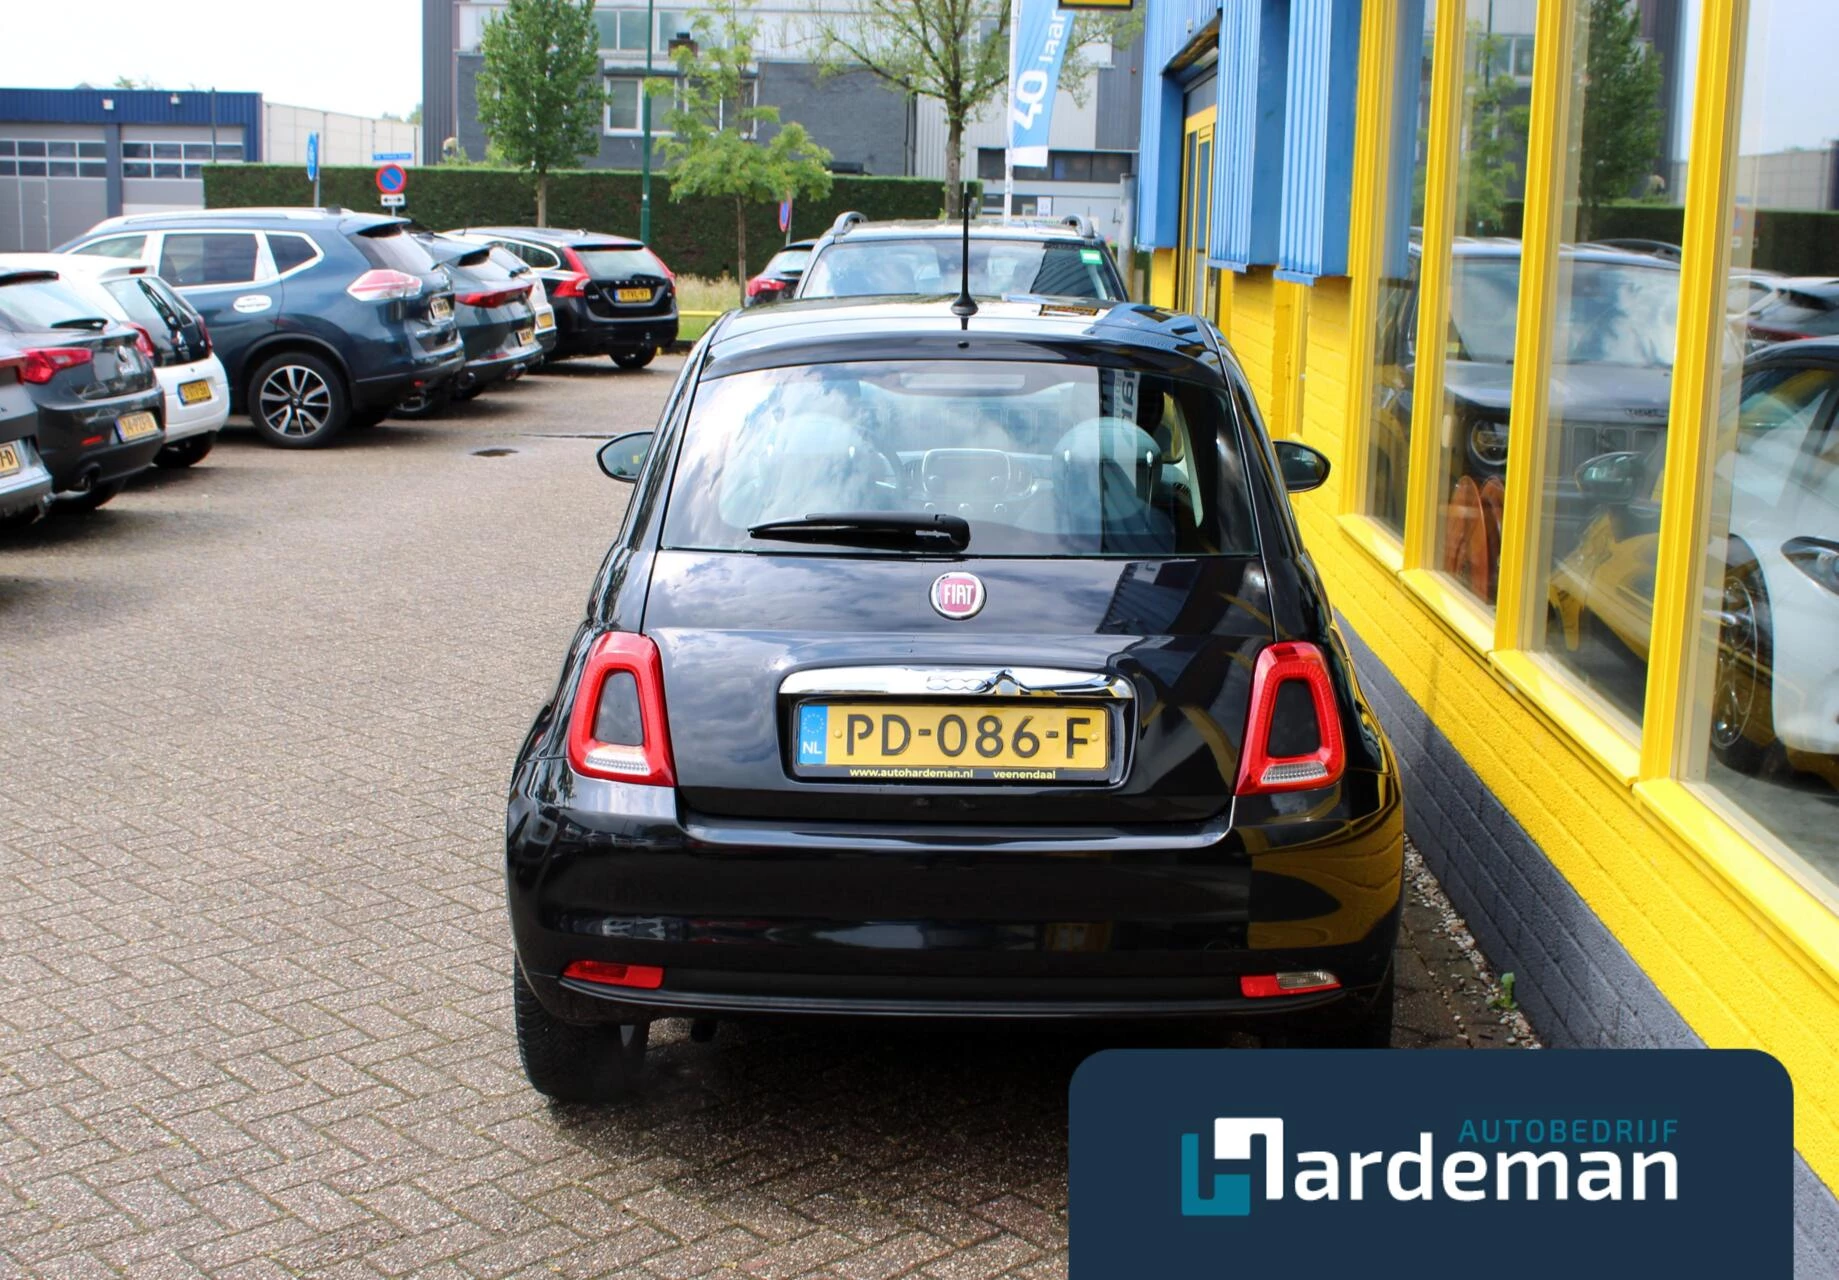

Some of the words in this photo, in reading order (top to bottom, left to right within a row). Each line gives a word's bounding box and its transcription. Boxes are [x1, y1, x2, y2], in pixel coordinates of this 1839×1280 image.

[1012, 70, 1048, 131] 40
[944, 583, 975, 605] FIAT
[846, 713, 1091, 759] PD-086-F
[802, 742, 822, 755] NL
[849, 767, 974, 779] www.autohardeman.nl
[993, 769, 1056, 780] veenendaal
